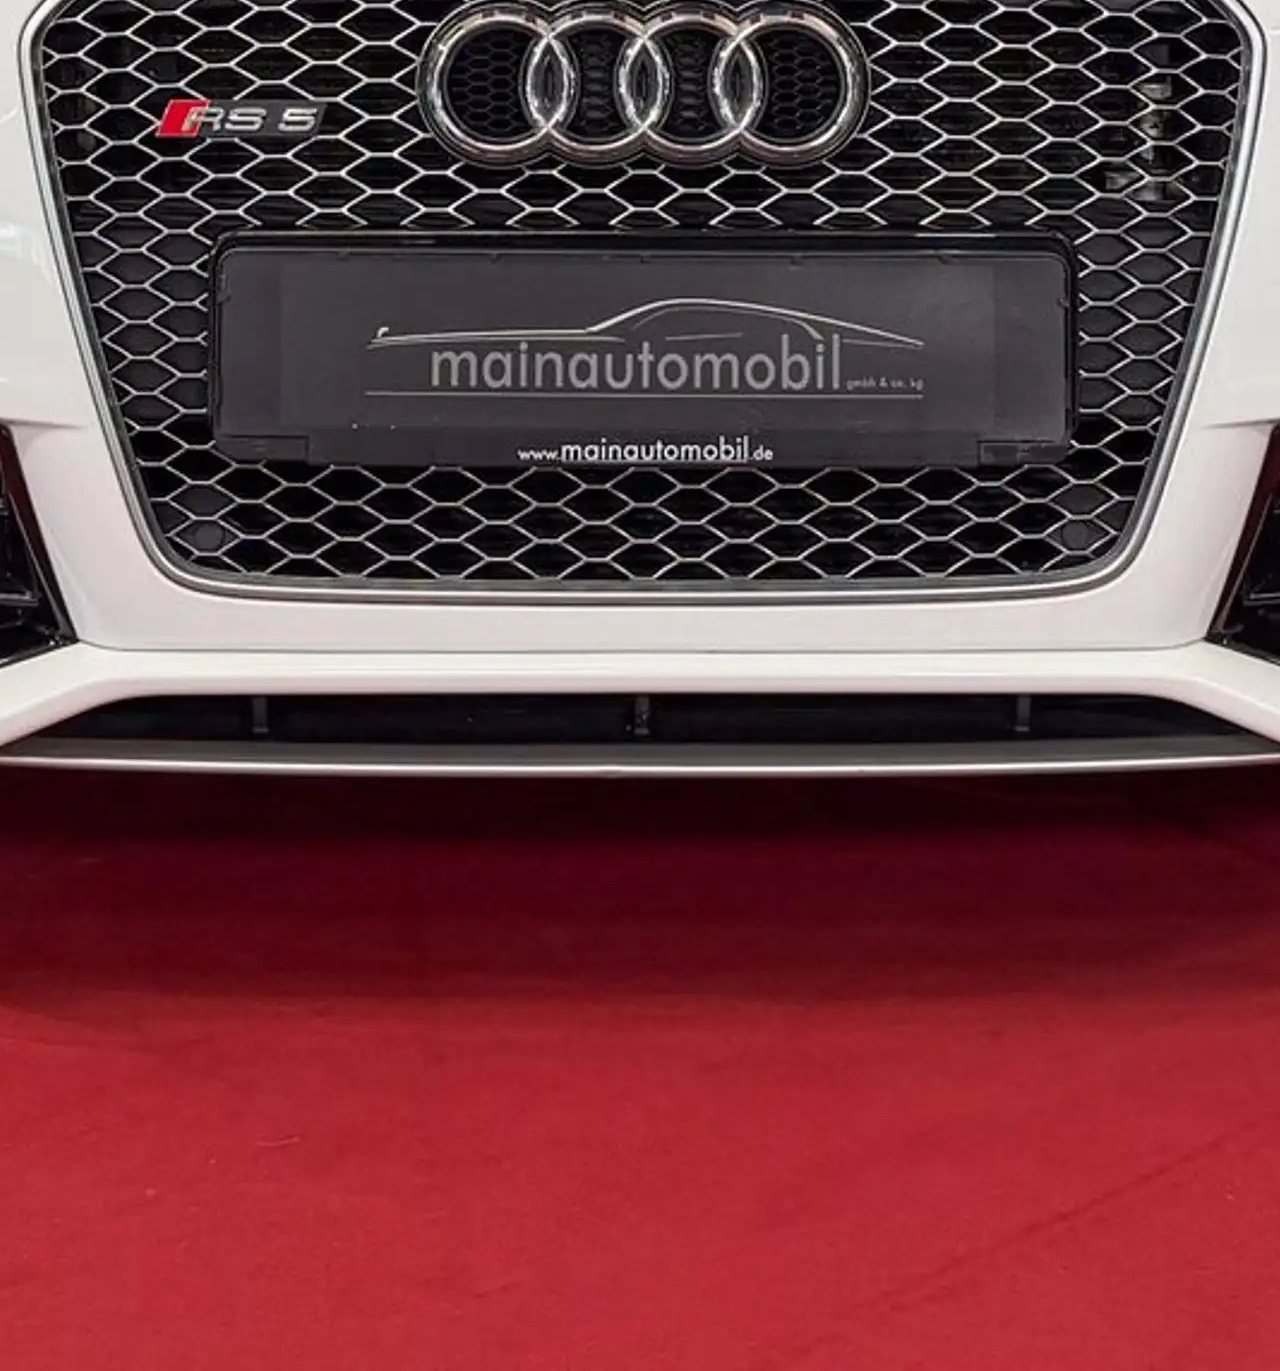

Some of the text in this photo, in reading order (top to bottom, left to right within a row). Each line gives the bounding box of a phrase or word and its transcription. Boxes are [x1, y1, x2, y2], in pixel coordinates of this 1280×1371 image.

[180, 106, 318, 132] RS 5
[430, 332, 841, 391] mainautomobil
[517, 435, 774, 462] www.mainautomobil.de
